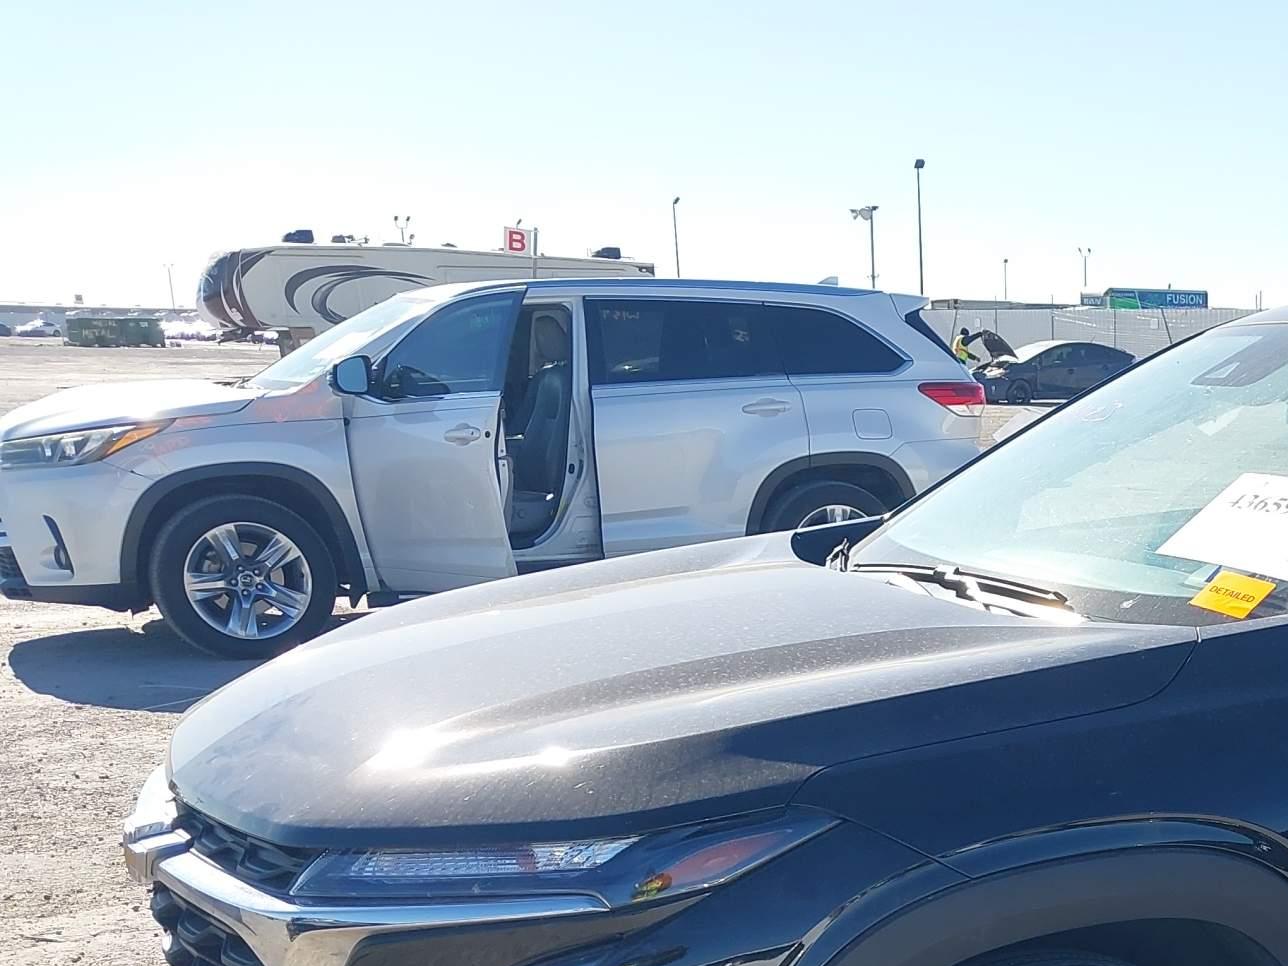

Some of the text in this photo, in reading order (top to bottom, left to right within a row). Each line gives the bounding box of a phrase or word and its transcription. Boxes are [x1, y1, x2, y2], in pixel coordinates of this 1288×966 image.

[508, 230, 526, 251] B
[1166, 293, 1203, 305] FUSION
[1208, 585, 1256, 604] DETAILED
